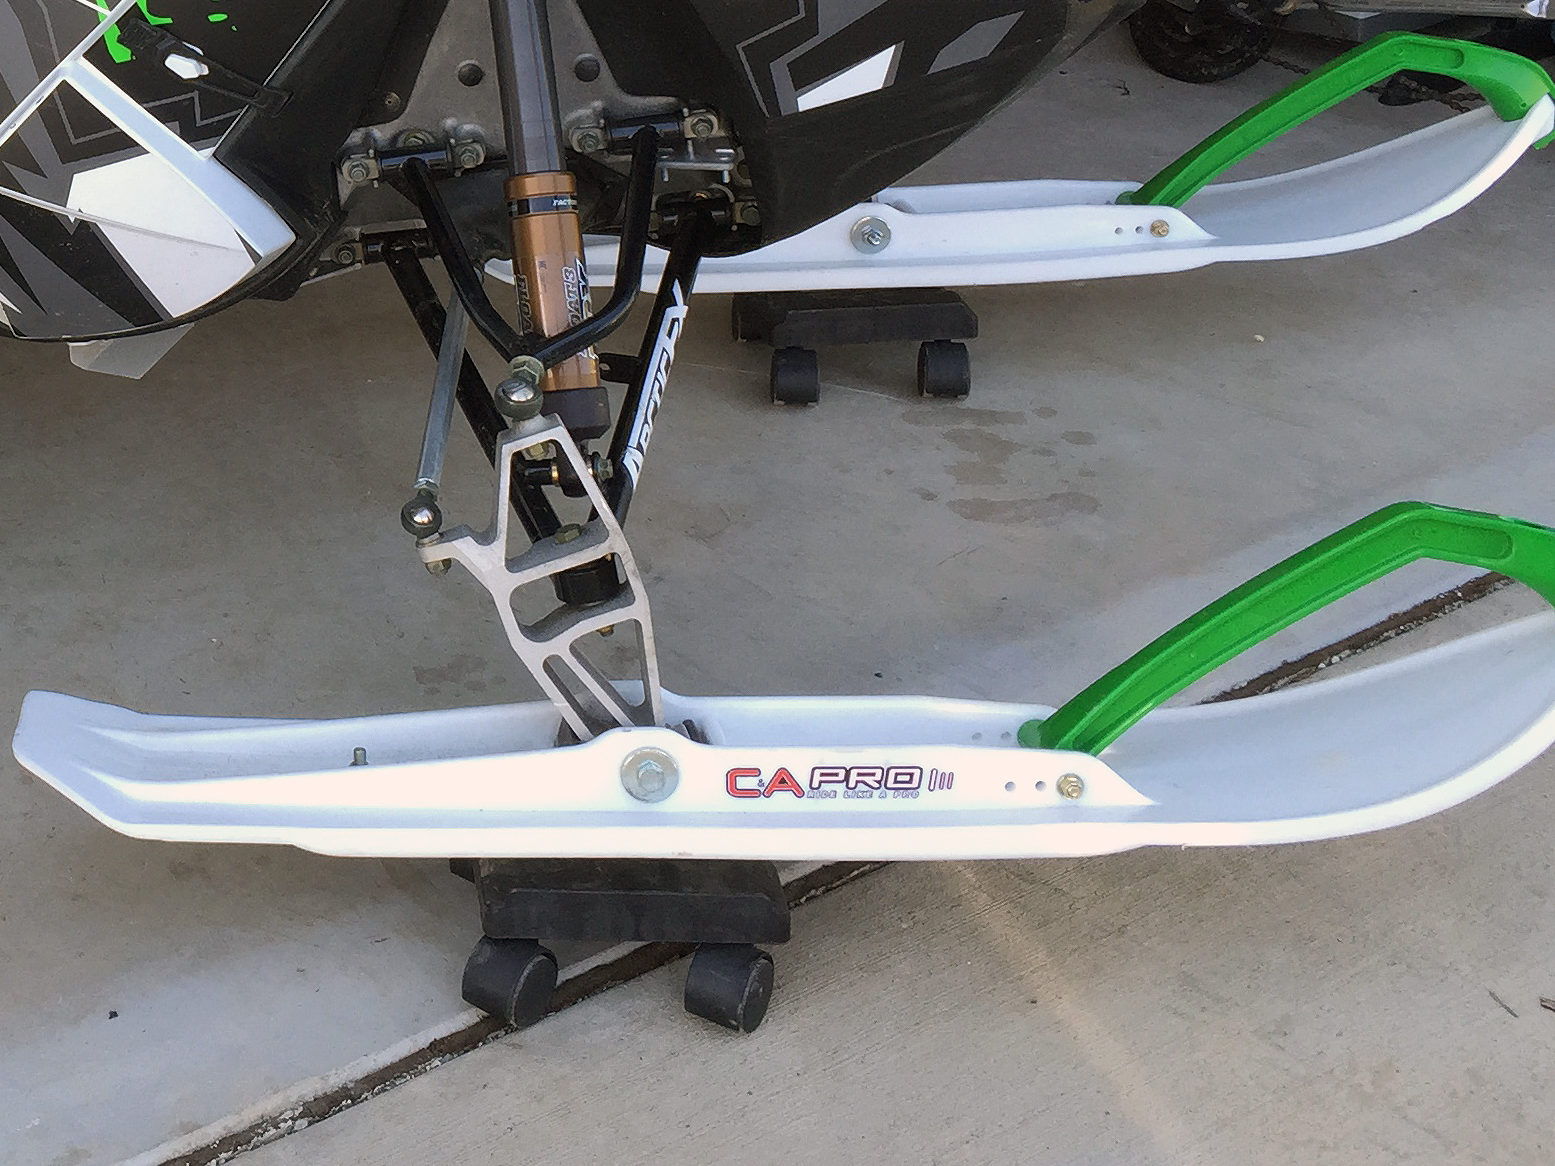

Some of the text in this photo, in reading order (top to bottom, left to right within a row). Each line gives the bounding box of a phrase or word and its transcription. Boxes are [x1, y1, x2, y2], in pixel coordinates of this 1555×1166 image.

[808, 766, 924, 791] PRO
[806, 790, 838, 800] RIDE
[842, 790, 874, 800] LIKE
